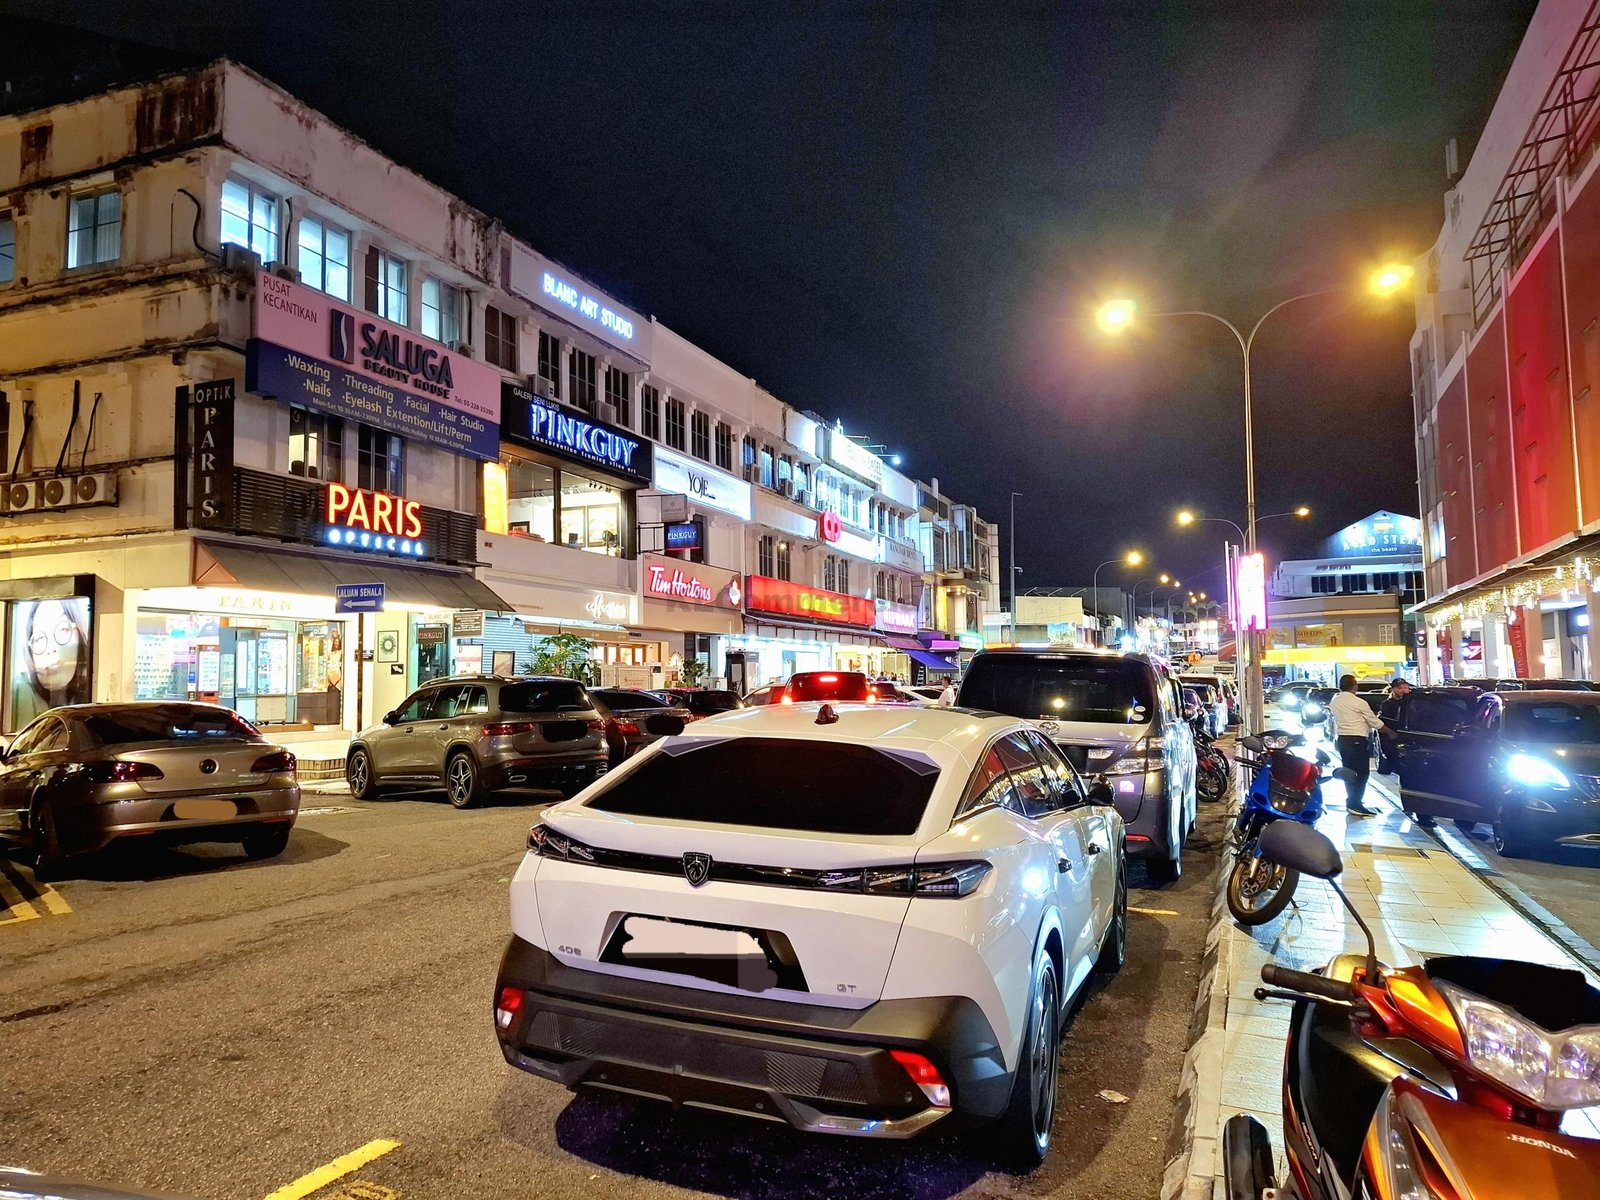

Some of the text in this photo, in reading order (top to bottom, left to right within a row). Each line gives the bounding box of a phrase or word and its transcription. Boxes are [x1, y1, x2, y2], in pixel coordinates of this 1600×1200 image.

[263, 276, 291, 297] PUSAT
[263, 292, 317, 323] KECANTIKAN
[543, 273, 633, 340] BLANC ART STUDIO
[361, 322, 453, 389] SALUGA
[195, 384, 231, 403] OPTIK
[287, 354, 485, 433] Waxing Threading Facial Hair Studio
[364, 359, 450, 400] BEAUTY HOUSE
[305, 379, 472, 443] Nails Eyelash Extention/Lift/Perm
[513, 387, 560, 412] GALERI SENI LUKIS
[530, 403, 636, 466] PINKGUY
[201, 407, 218, 519] PARIS
[328, 483, 422, 538] PARIS
[329, 528, 424, 555] OPTICAL
[668, 531, 697, 540] PINKGUY
[337, 587, 382, 598] LALUAN SEHALA
[649, 566, 712, 601] Tim Hortons
[418, 631, 443, 639] PINKGUY
[836, 983, 857, 993] GT
[1511, 1133, 1579, 1160] HONDA
